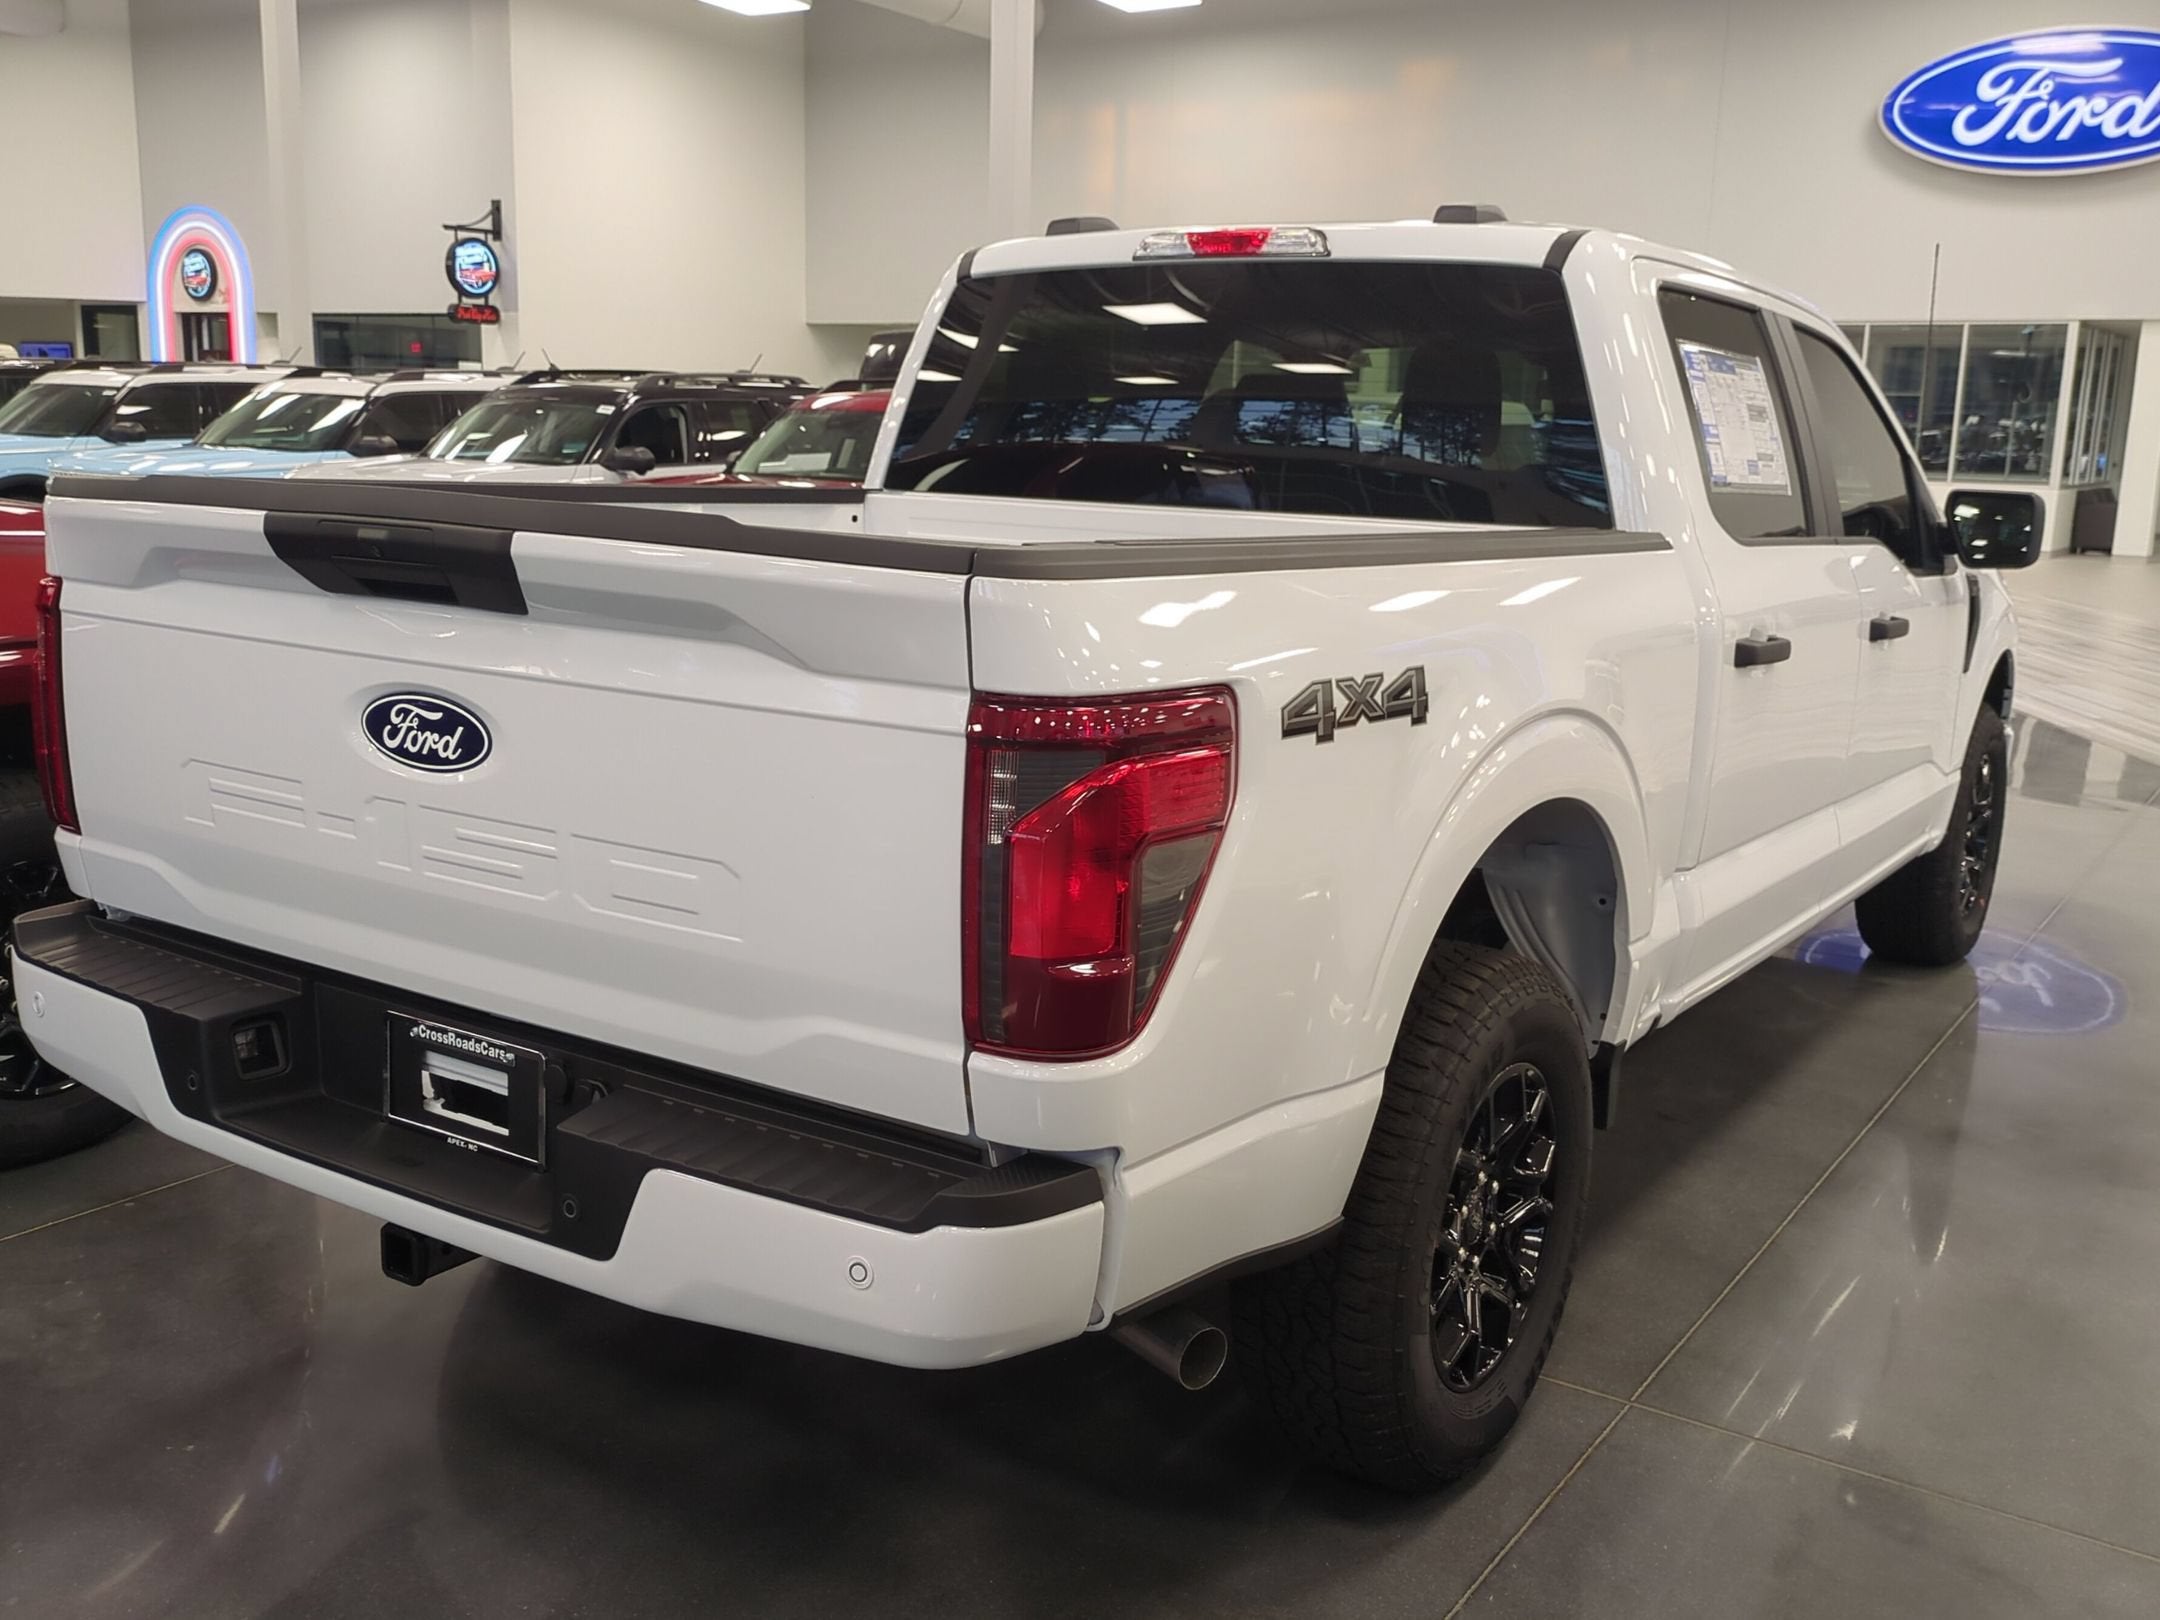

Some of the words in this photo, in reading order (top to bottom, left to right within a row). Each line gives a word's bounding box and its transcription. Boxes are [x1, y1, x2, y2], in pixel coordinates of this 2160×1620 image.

[1952, 58, 2160, 146] Ford
[383, 703, 464, 761] Ford
[182, 757, 742, 943] F-150
[419, 1024, 506, 1061] CrossRoadsCars
[468, 1143, 479, 1152] NC
